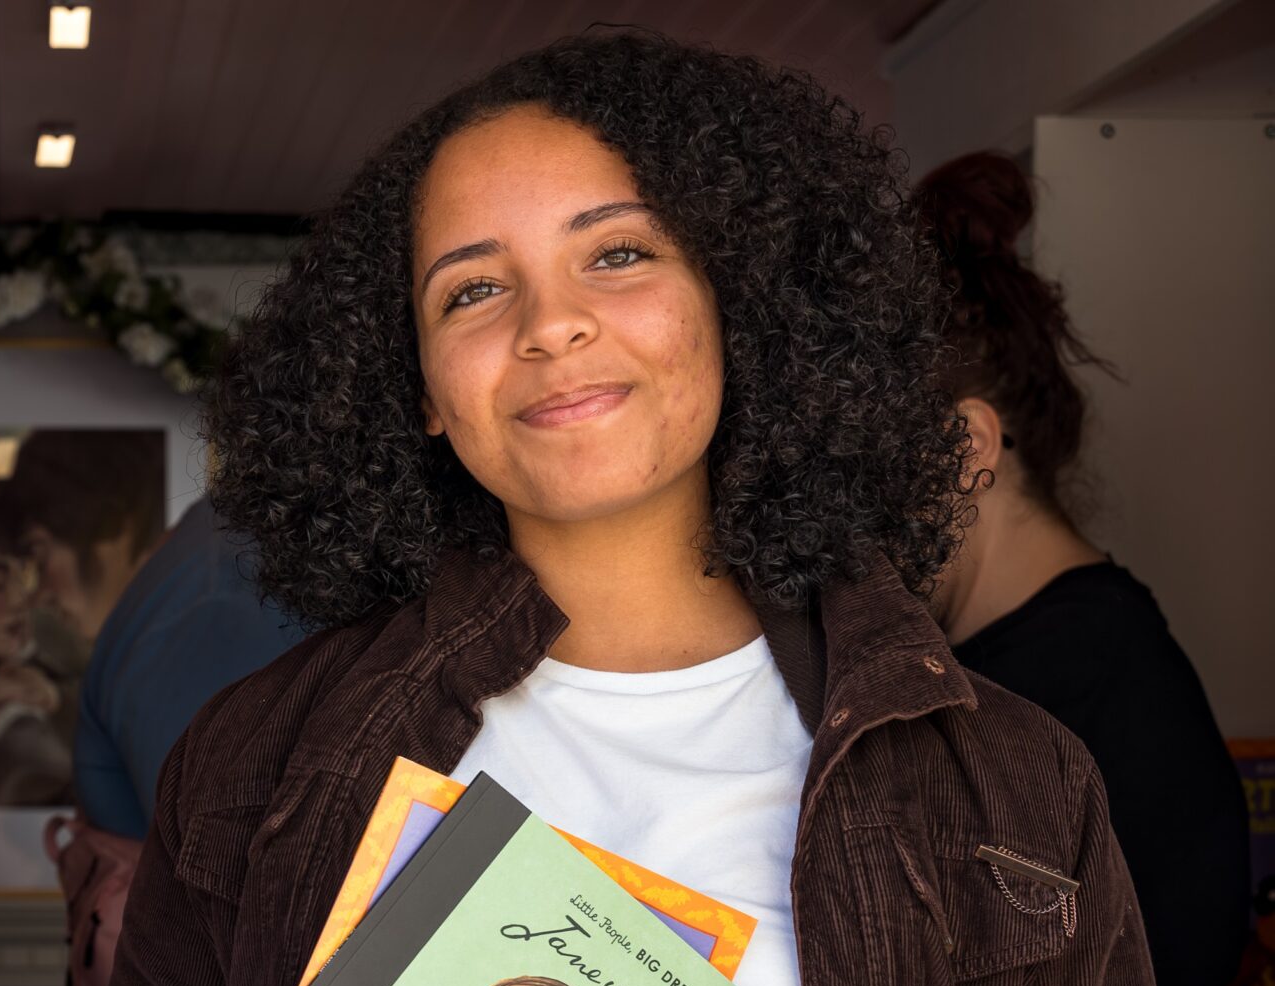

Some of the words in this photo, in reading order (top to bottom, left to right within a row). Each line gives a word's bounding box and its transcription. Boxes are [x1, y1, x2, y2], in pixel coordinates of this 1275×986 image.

[500, 915, 602, 985] Jane
[570, 894, 598, 922] Little
[598, 917, 632, 954] People,
[636, 948, 662, 974] BIG
